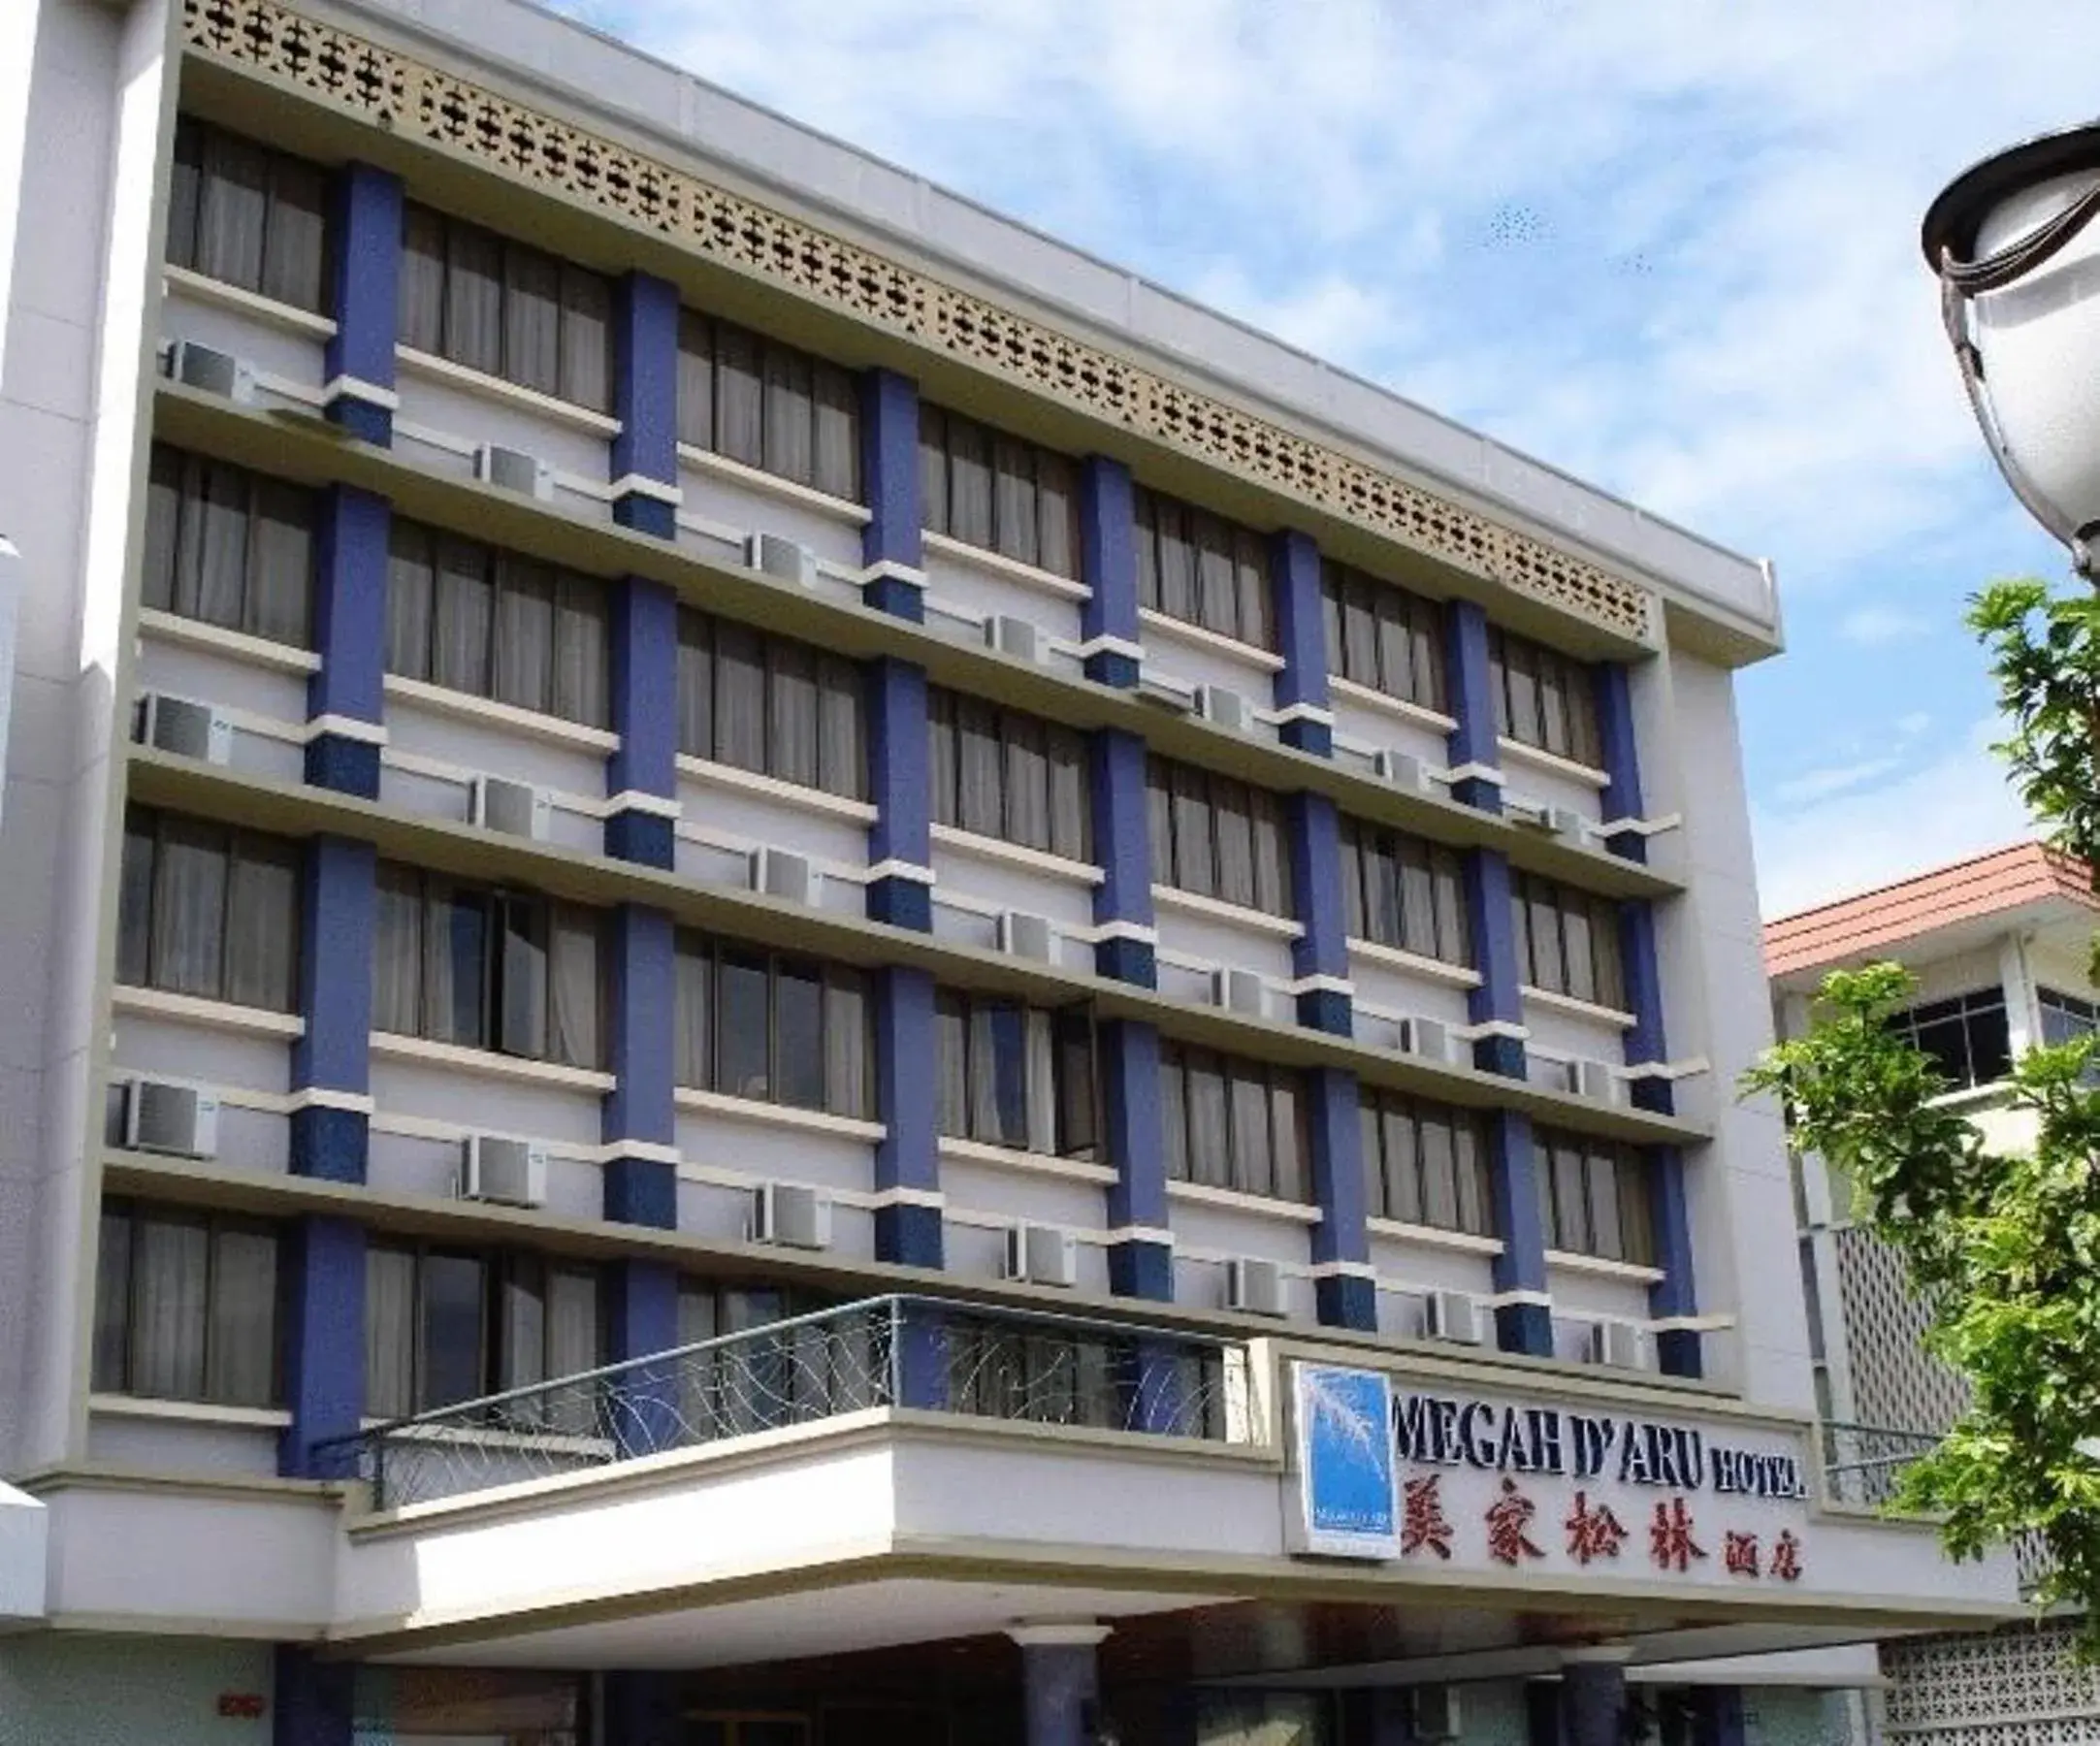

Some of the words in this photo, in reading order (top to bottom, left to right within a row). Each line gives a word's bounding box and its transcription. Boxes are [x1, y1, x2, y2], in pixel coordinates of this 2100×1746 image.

[1392, 1394, 1565, 1474] MEGAH
[1568, 1414, 1703, 1490] D'ARU
[1711, 1447, 1809, 1499] HOTEL
